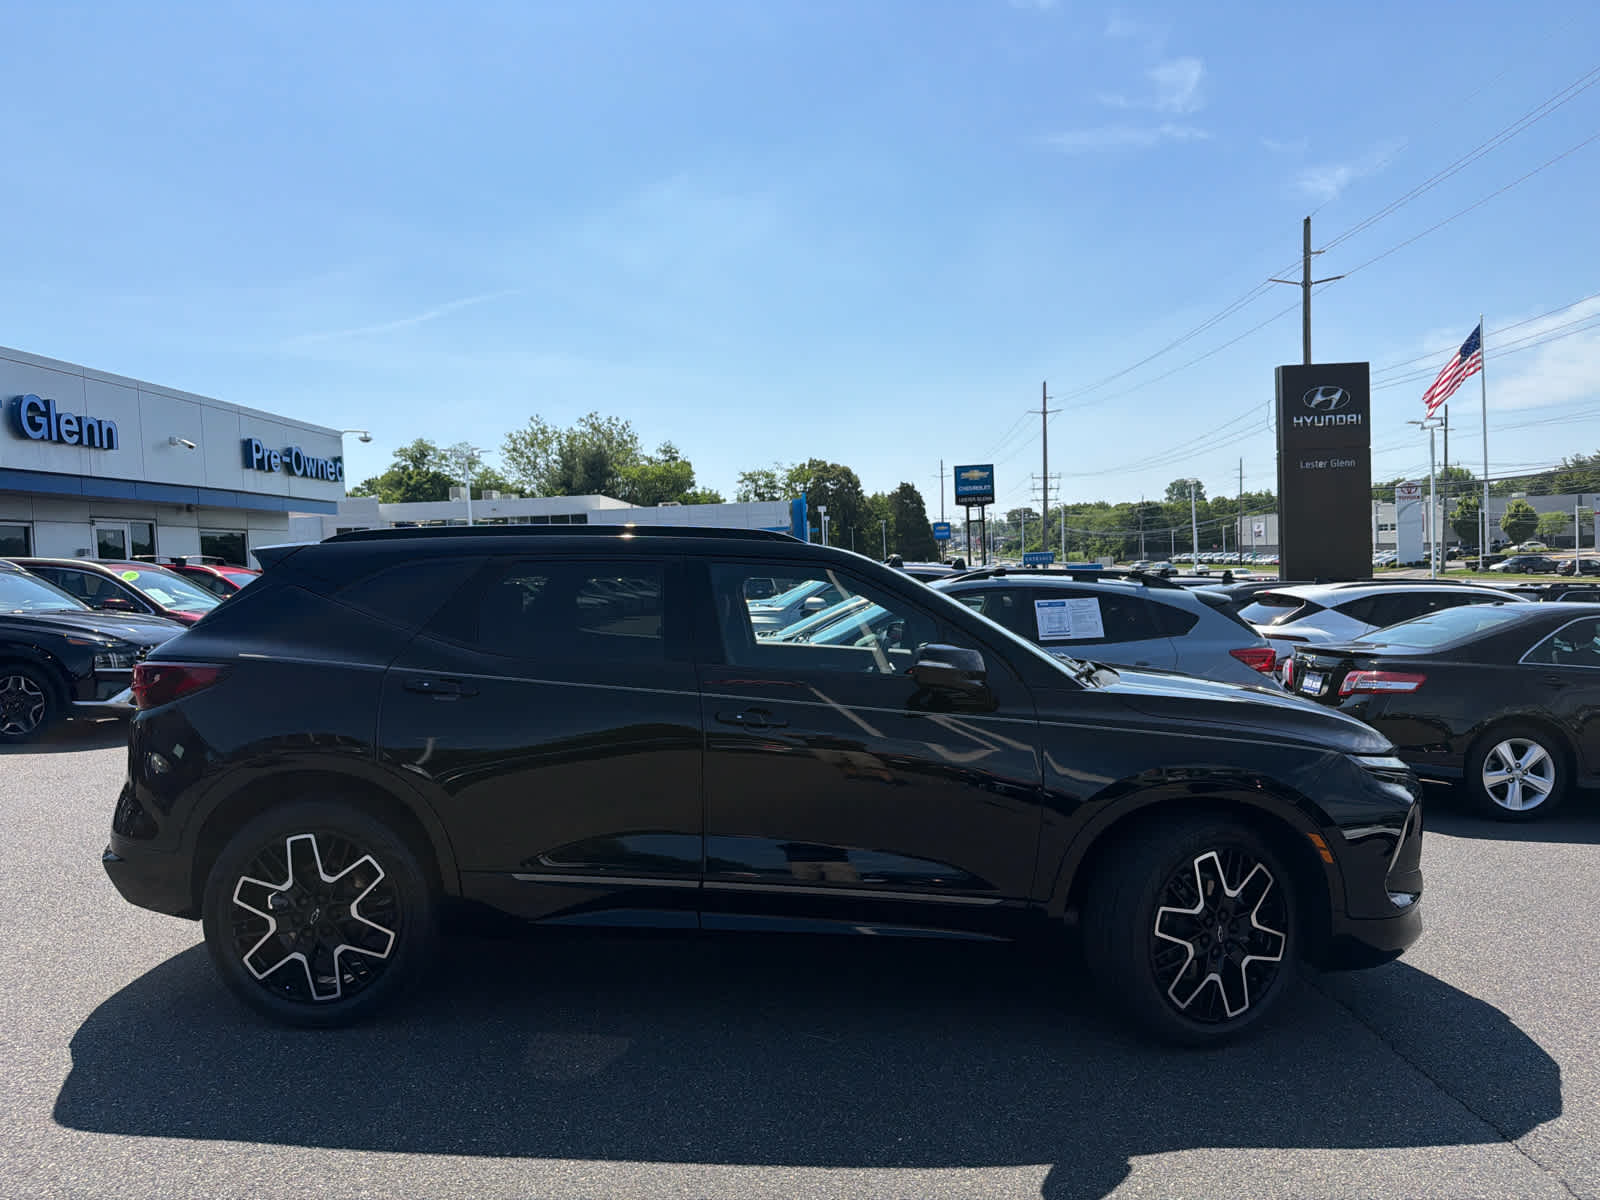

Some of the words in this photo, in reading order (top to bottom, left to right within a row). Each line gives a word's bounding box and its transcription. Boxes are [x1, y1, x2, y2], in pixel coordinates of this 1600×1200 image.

[17, 393, 119, 450] Glenn
[1293, 413, 1362, 428] HYUNDAI
[1300, 460, 1328, 470] Lester
[1330, 459, 1356, 468] Glenn
